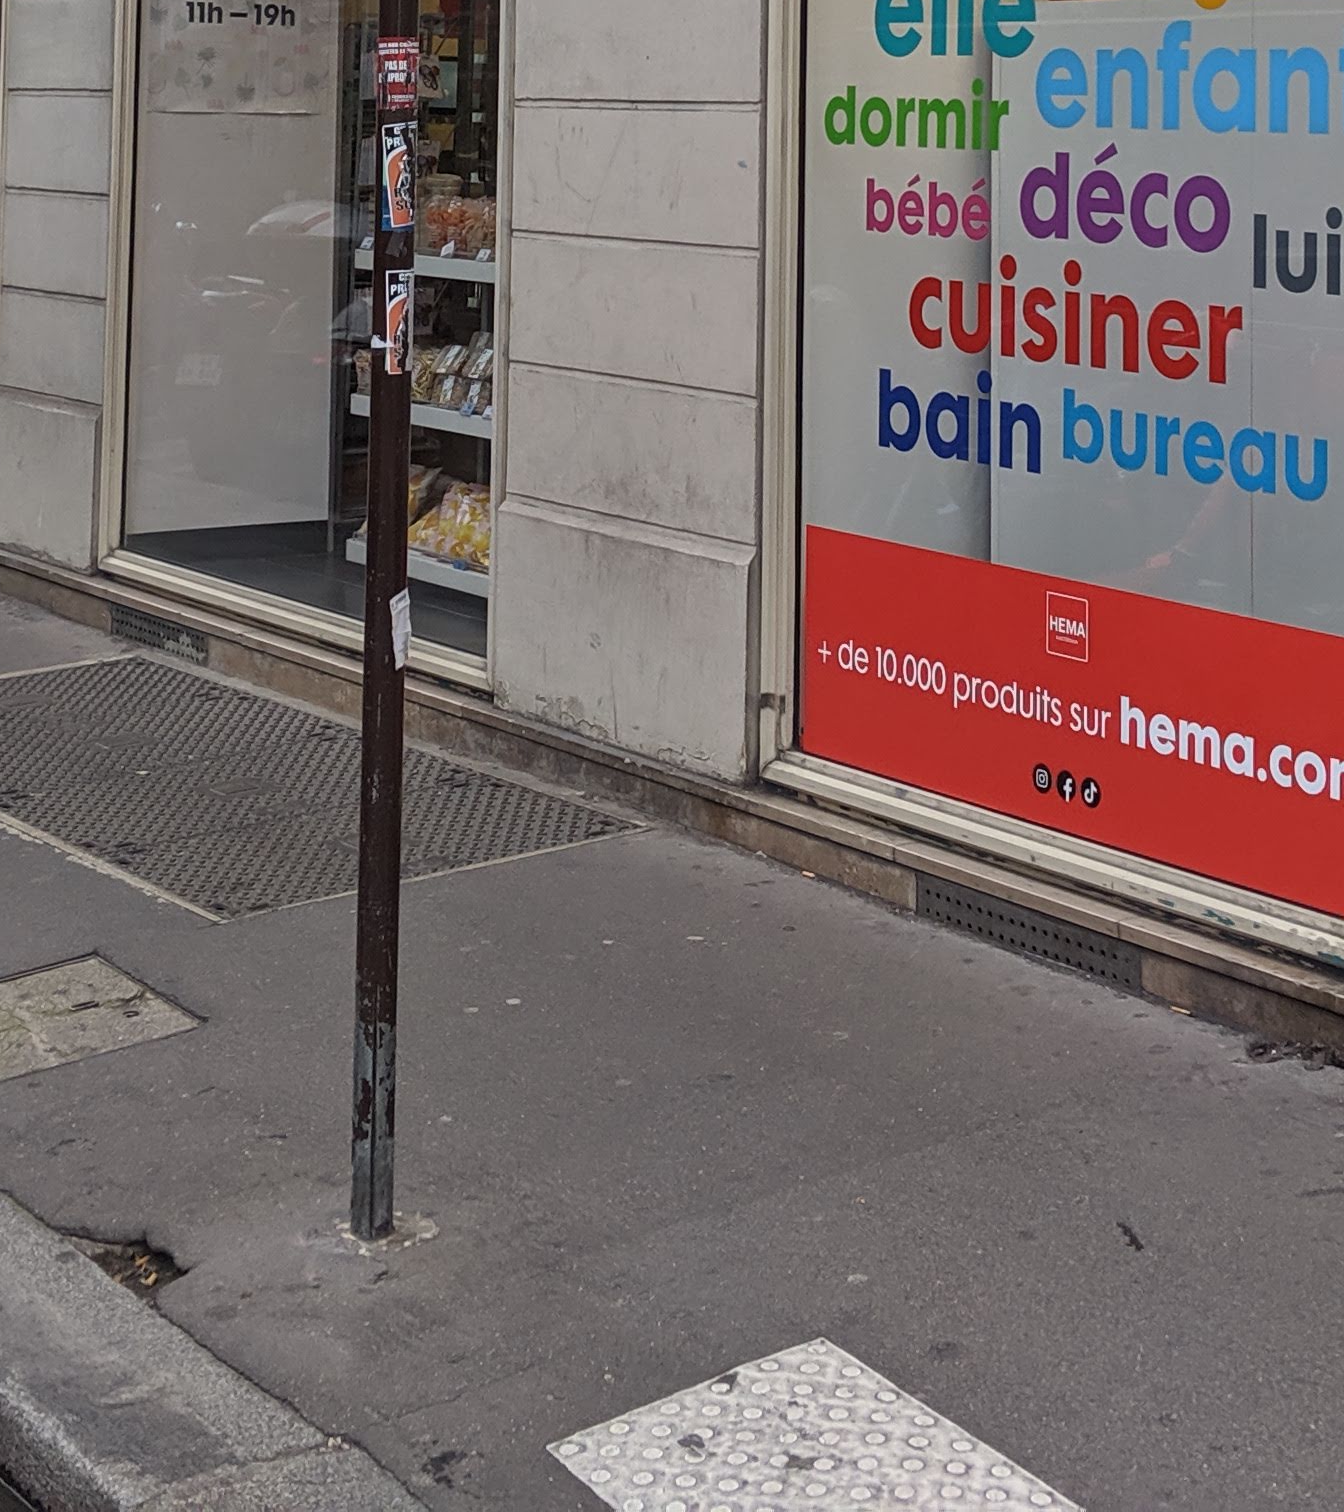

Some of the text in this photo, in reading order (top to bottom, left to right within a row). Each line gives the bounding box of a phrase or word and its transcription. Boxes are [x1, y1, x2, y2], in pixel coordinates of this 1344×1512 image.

[186, 0, 223, 24] 11h
[253, 3, 296, 27] 19h
[824, 78, 1010, 151] dormir
[866, 173, 992, 241] bébé
[1019, 142, 1231, 253] déco
[1253, 206, 1343, 296] lui
[908, 254, 1243, 384] cuisiner
[878, 367, 1042, 474] bain
[1062, 387, 1329, 501] bureau
[1049, 614, 1087, 639] HEMA
[837, 639, 869, 675] de
[875, 645, 947, 695] 10.000
[953, 670, 1062, 727] produits
[1069, 699, 1112, 740] sur
